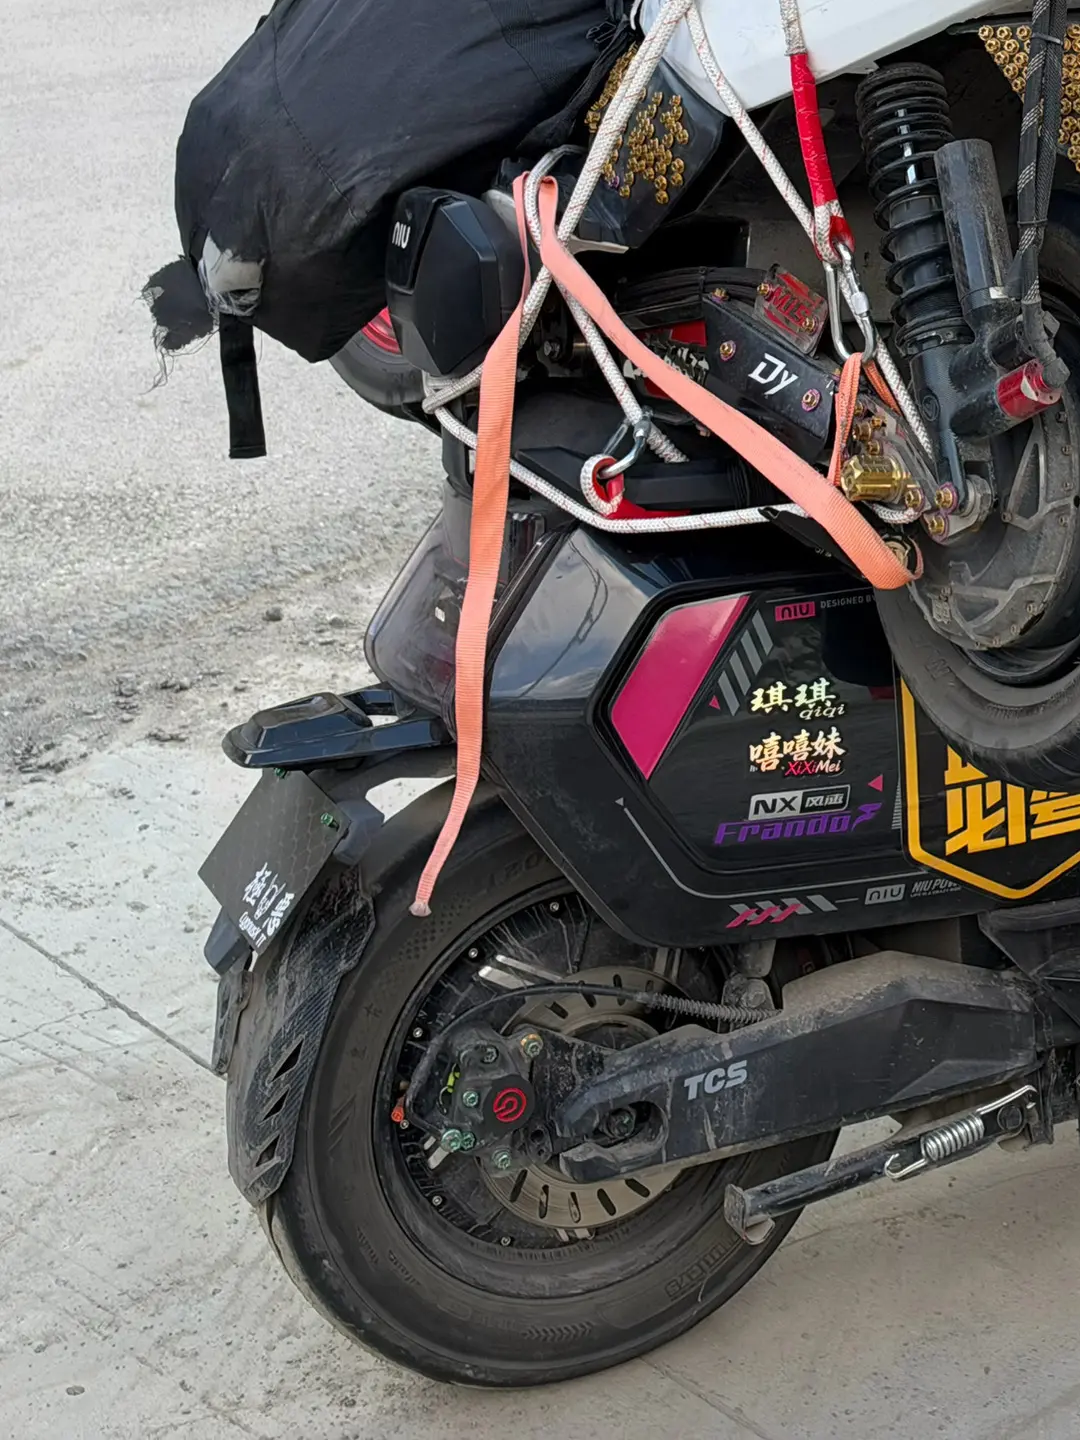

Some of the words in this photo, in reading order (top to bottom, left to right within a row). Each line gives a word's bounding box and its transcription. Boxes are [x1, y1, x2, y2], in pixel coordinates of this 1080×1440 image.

[392, 221, 411, 249] NIU
[781, 603, 810, 619] NIU
[820, 596, 864, 608] DESIGNED
[750, 677, 836, 714] 琪琪
[799, 703, 845, 720] qiqi
[749, 726, 846, 772] 嘻嘻妹
[784, 760, 841, 776] XiXiMei
[753, 796, 798, 815] NX
[868, 887, 902, 902] NIU
[684, 1060, 747, 1100] TCS
